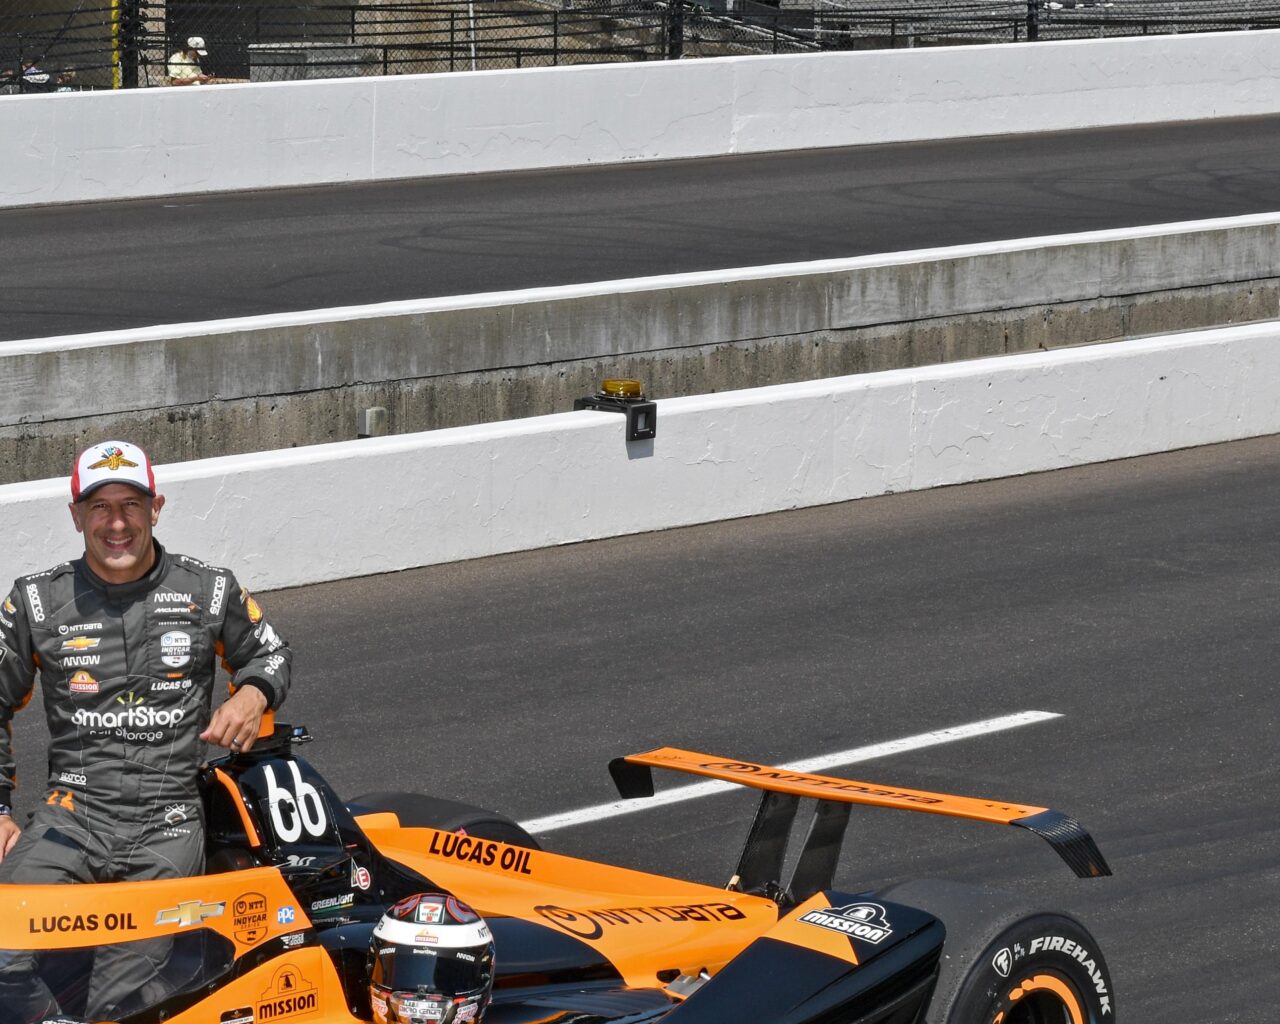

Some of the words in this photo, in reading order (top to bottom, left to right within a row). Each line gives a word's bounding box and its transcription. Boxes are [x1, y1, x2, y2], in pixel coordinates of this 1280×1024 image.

[27, 583, 45, 622] sparco
[210, 575, 226, 615] sparco
[151, 681, 181, 690] LUCAS
[71, 706, 185, 728] SmartStop
[262, 760, 327, 843] 66
[429, 831, 497, 867] LUCAS
[500, 848, 533, 875] OIL
[248, 901, 264, 911] NTT
[587, 906, 662, 926] NTT
[29, 915, 99, 933] LUCAS
[103, 913, 138, 931] OIL
[233, 914, 267, 926] INDYCAR
[1029, 936, 1111, 1016] FIREHAWK
